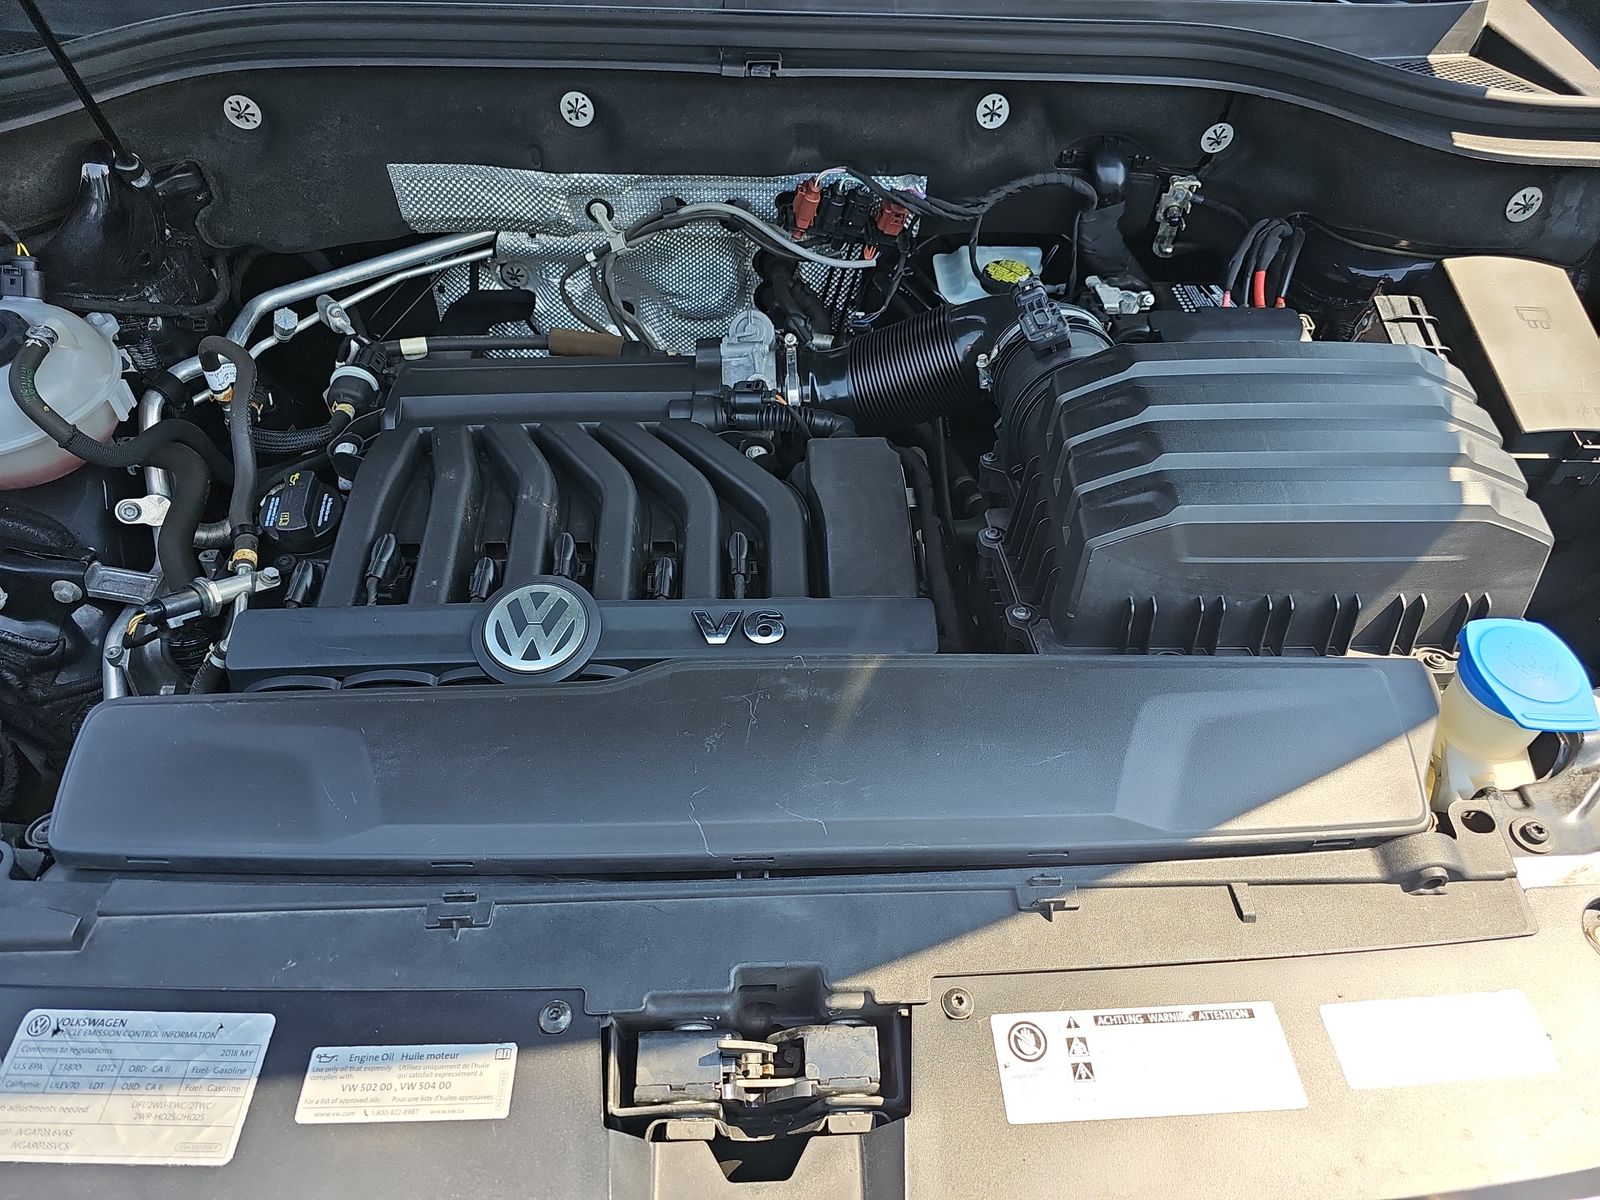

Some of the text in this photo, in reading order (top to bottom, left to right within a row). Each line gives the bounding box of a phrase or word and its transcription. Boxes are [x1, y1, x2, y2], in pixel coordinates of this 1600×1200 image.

[691, 609, 787, 645] V6
[1098, 1013, 1144, 1025] ACHTUNG
[1199, 1008, 1249, 1021] ATTENTION
[56, 1017, 128, 1028] VOLKSWAGEN
[83, 1028, 120, 1037] EMISSION
[122, 1029, 159, 1038] CONTROL
[161, 1030, 217, 1039] INFORMATION
[20, 1045, 58, 1054] Conforms
[60, 1046, 68, 1054] to
[220, 1049, 238, 1057] 2018
[349, 1052, 395, 1064] Engine Oil
[401, 1051, 460, 1061] Huile moteur
[213, 1066, 247, 1075] Gasoline
[206, 1084, 242, 1093] Gasoline
[341, 1083, 358, 1092] VW
[360, 1083, 378, 1092] 502
[379, 1082, 393, 1092] 00
[400, 1082, 417, 1090] VW
[419, 1082, 436, 1090] 504
[438, 1081, 452, 1090] 00
